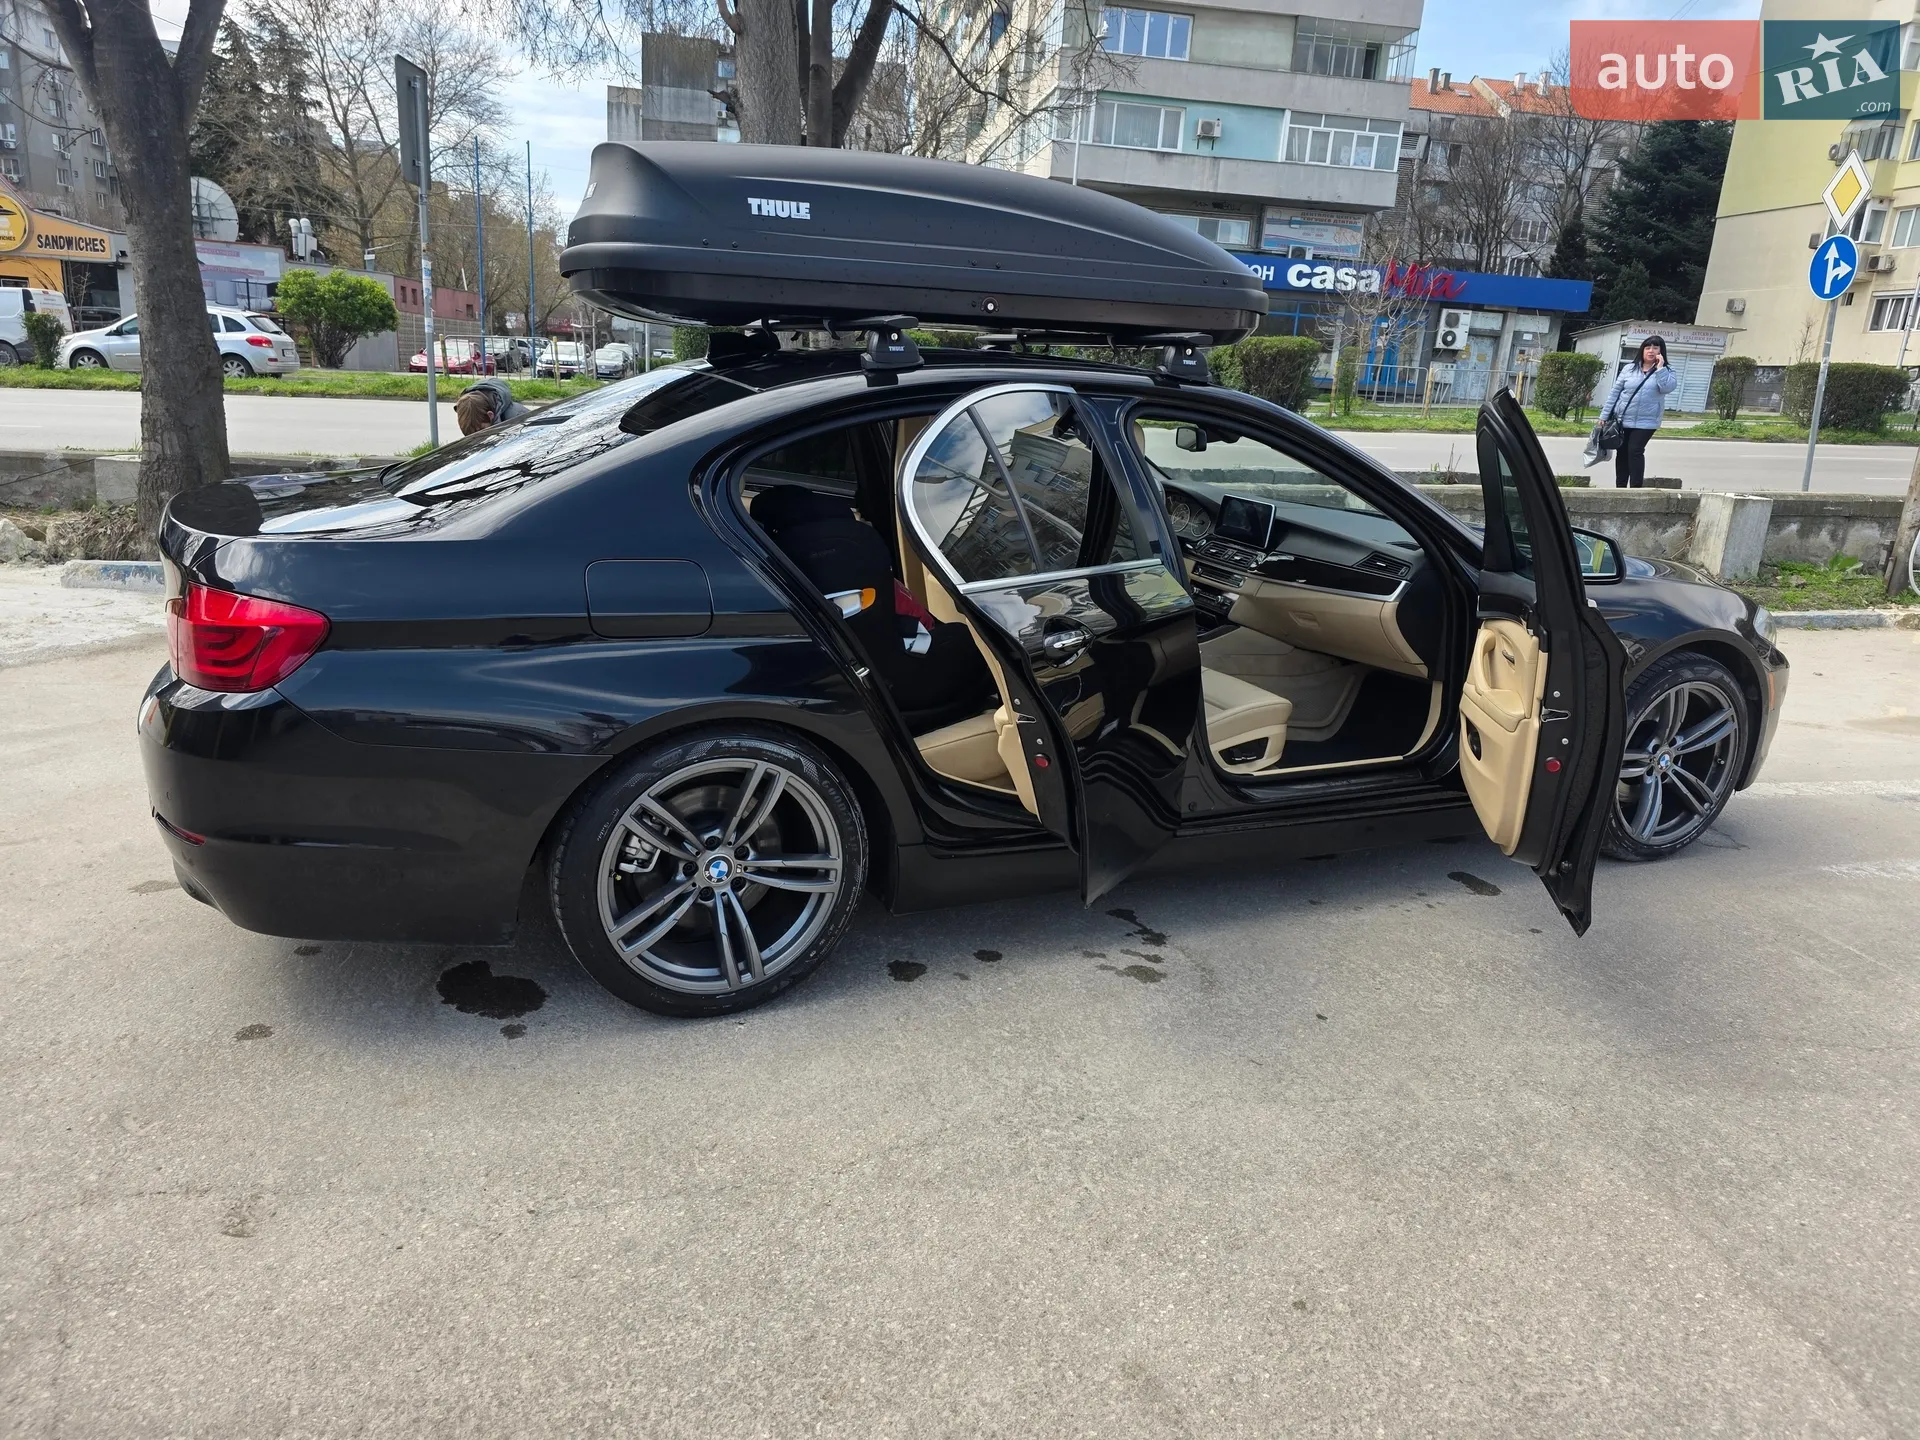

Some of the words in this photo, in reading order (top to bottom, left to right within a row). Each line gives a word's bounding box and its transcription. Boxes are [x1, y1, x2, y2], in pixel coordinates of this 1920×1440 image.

[747, 197, 811, 220] THULE
[37, 234, 106, 253] SANDWICHES
[1246, 264, 1275, 281] ОН
[1287, 263, 1381, 293] casa
